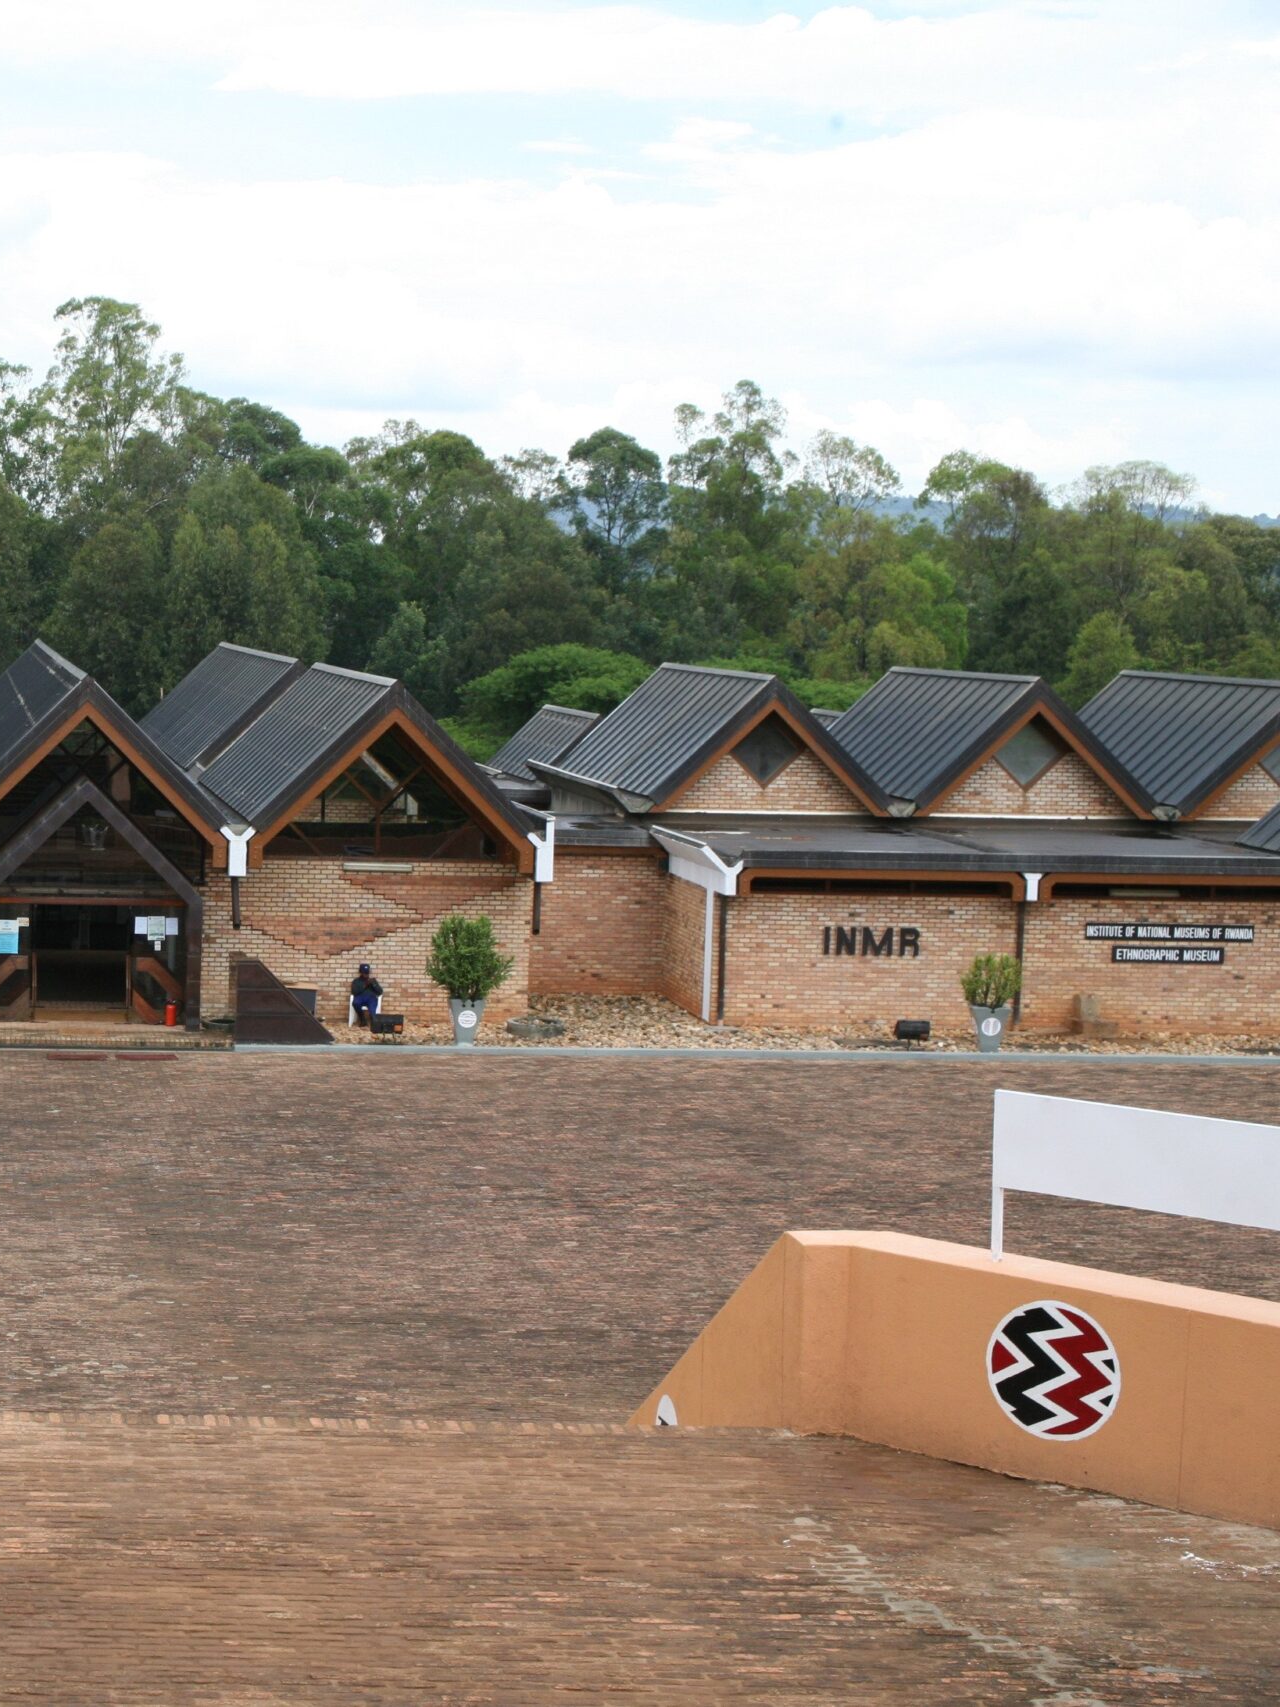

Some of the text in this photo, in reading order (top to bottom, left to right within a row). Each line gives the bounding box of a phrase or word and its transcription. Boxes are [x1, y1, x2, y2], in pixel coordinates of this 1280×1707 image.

[1086, 925, 1253, 940] INSTITUTE OF NATIONAL MUSEUMS OF RWANDA
[823, 926, 920, 957] INMR
[1116, 948, 1220, 962] ETHNOGRAPHIC MUSEUM
